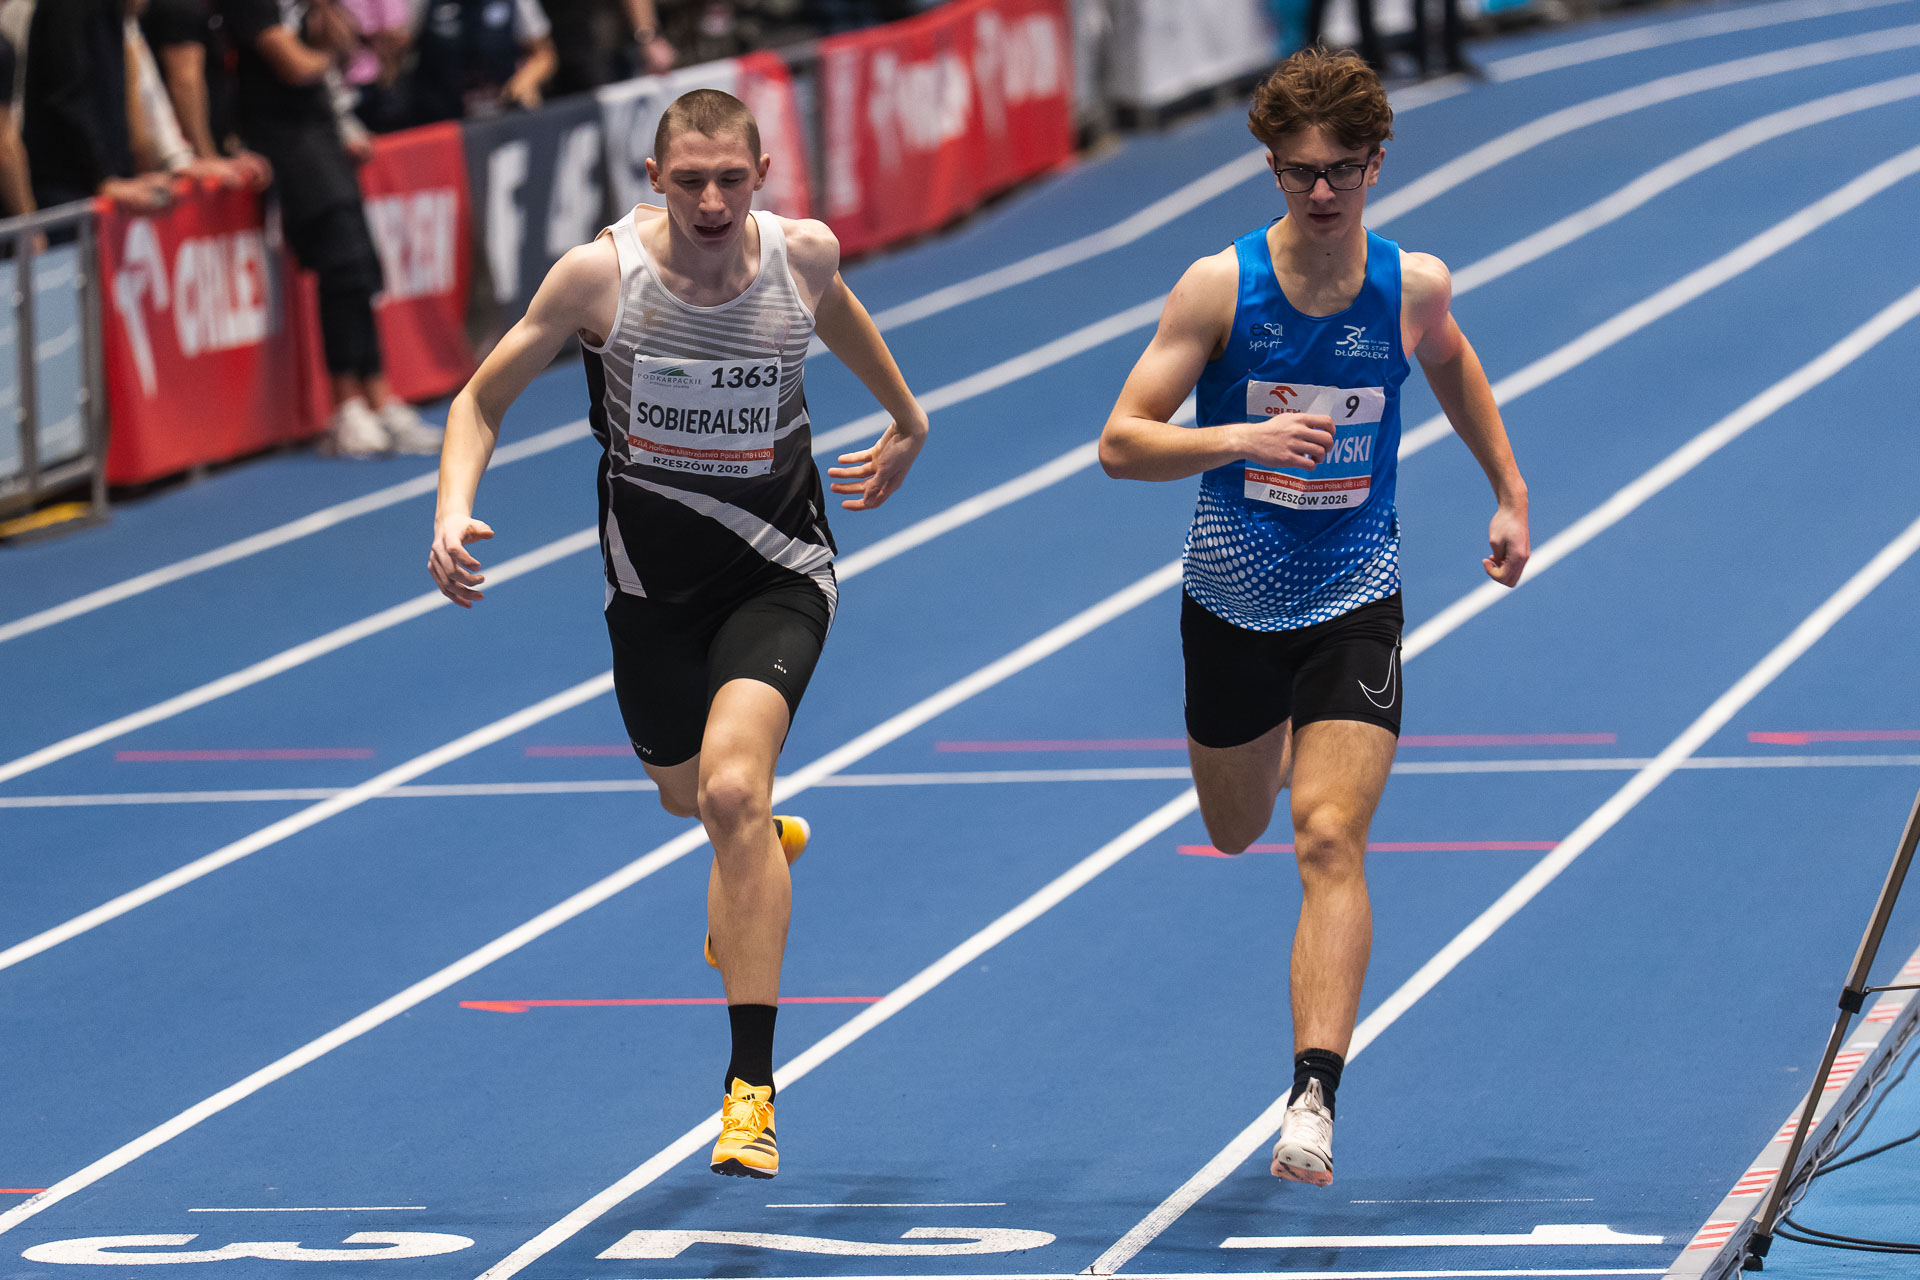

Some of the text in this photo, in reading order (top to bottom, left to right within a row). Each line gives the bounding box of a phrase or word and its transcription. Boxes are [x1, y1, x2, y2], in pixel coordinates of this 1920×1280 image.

[1335, 348, 1388, 360] DŁUGOŁĘKA
[637, 373, 702, 385] PODKARPACKIE
[711, 365, 778, 388] 1363
[1345, 395, 1360, 418] 9
[637, 402, 770, 434] SOBIERALSKI
[633, 438, 648, 449] PZLA
[649, 443, 676, 454] Halowe
[676, 448, 719, 458] Mistrzostwa
[720, 452, 741, 460] Polski
[652, 456, 748, 475] RZESZÓW 2026
[1249, 472, 1265, 481] PZLA
[1266, 474, 1289, 486] Halowe
[1324, 482, 1343, 490] Polski
[1269, 489, 1348, 506] RZESZÓW 2026
[595, 1227, 1057, 1259] 2
[1219, 1224, 1663, 1248] 1
[21, 1231, 475, 1265] 3
